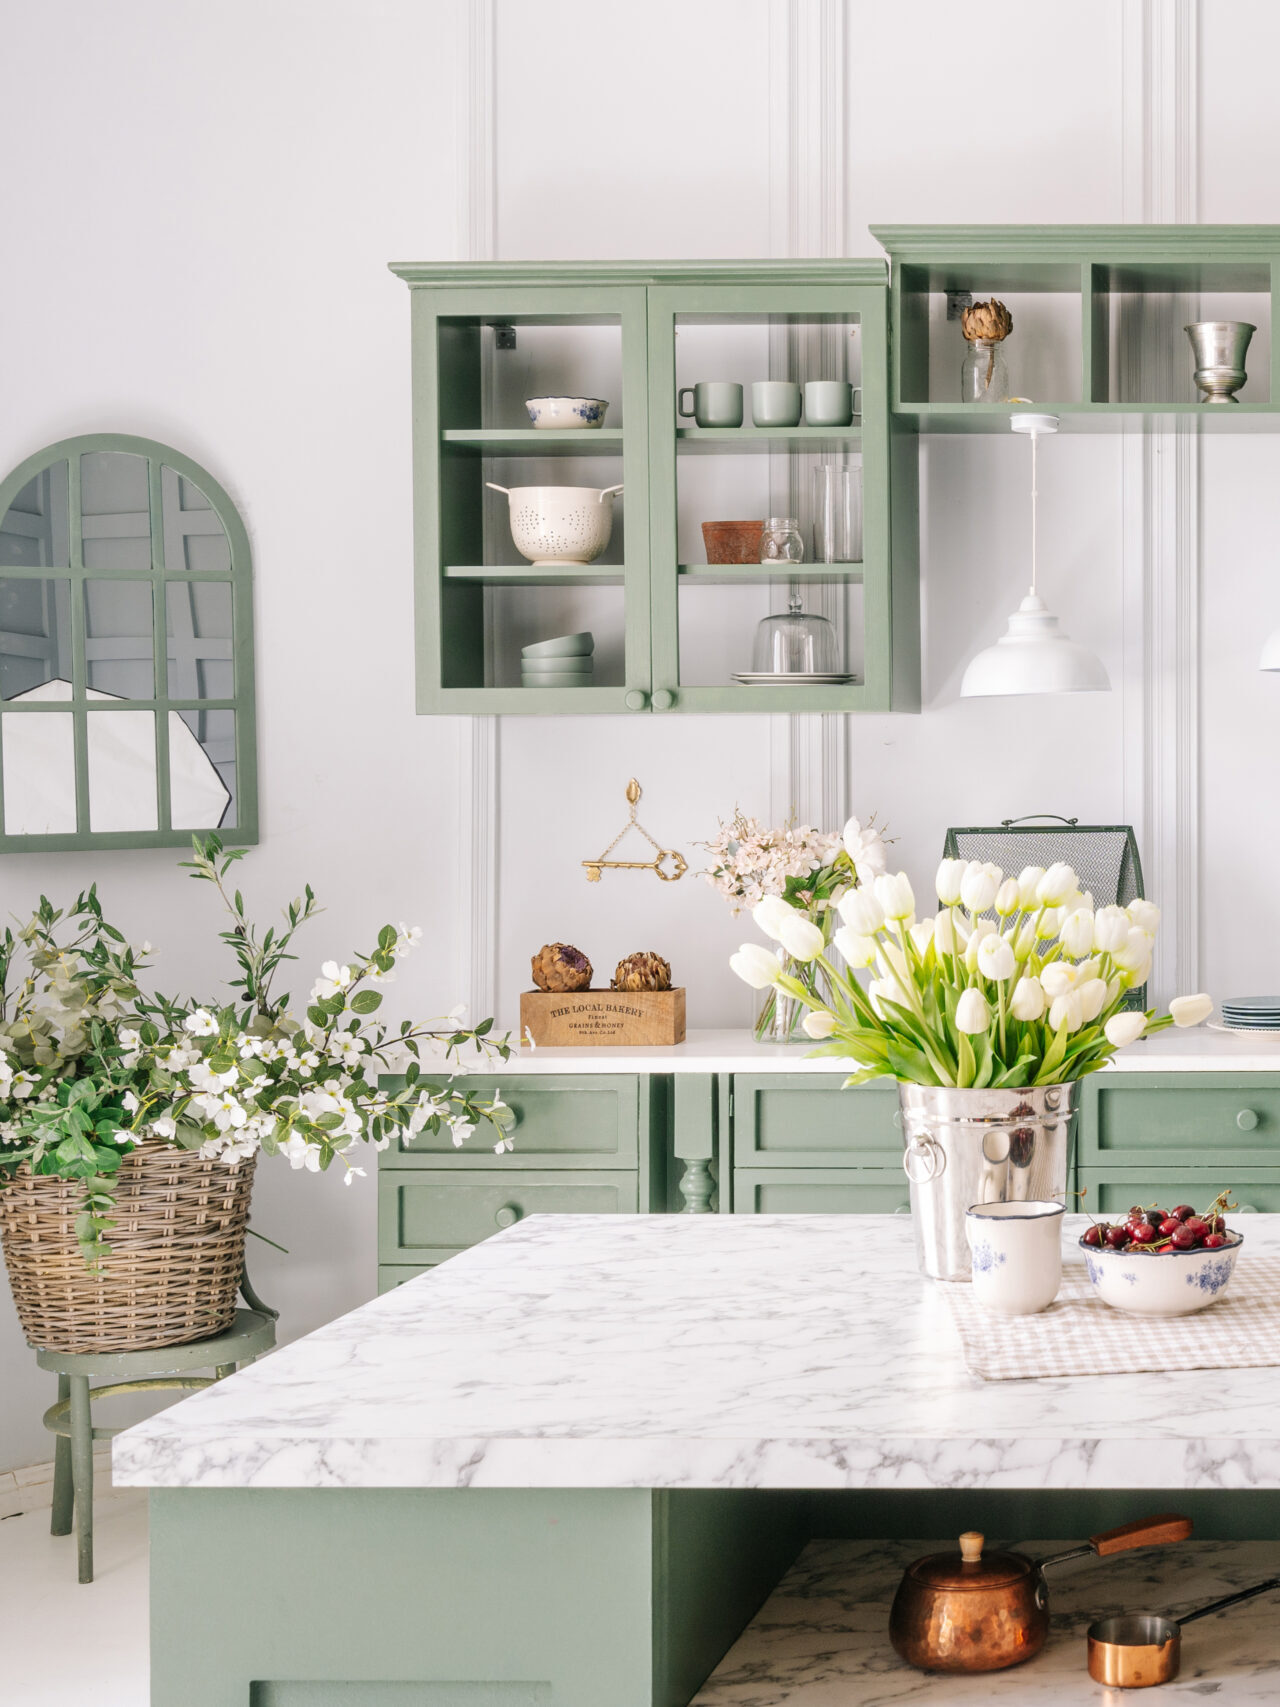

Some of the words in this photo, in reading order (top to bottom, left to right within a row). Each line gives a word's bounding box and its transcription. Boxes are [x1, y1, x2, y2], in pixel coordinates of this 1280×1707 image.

[550, 1006, 570, 1018] THE
[572, 1004, 603, 1013] LOCAL
[606, 1004, 645, 1018] BAKERY
